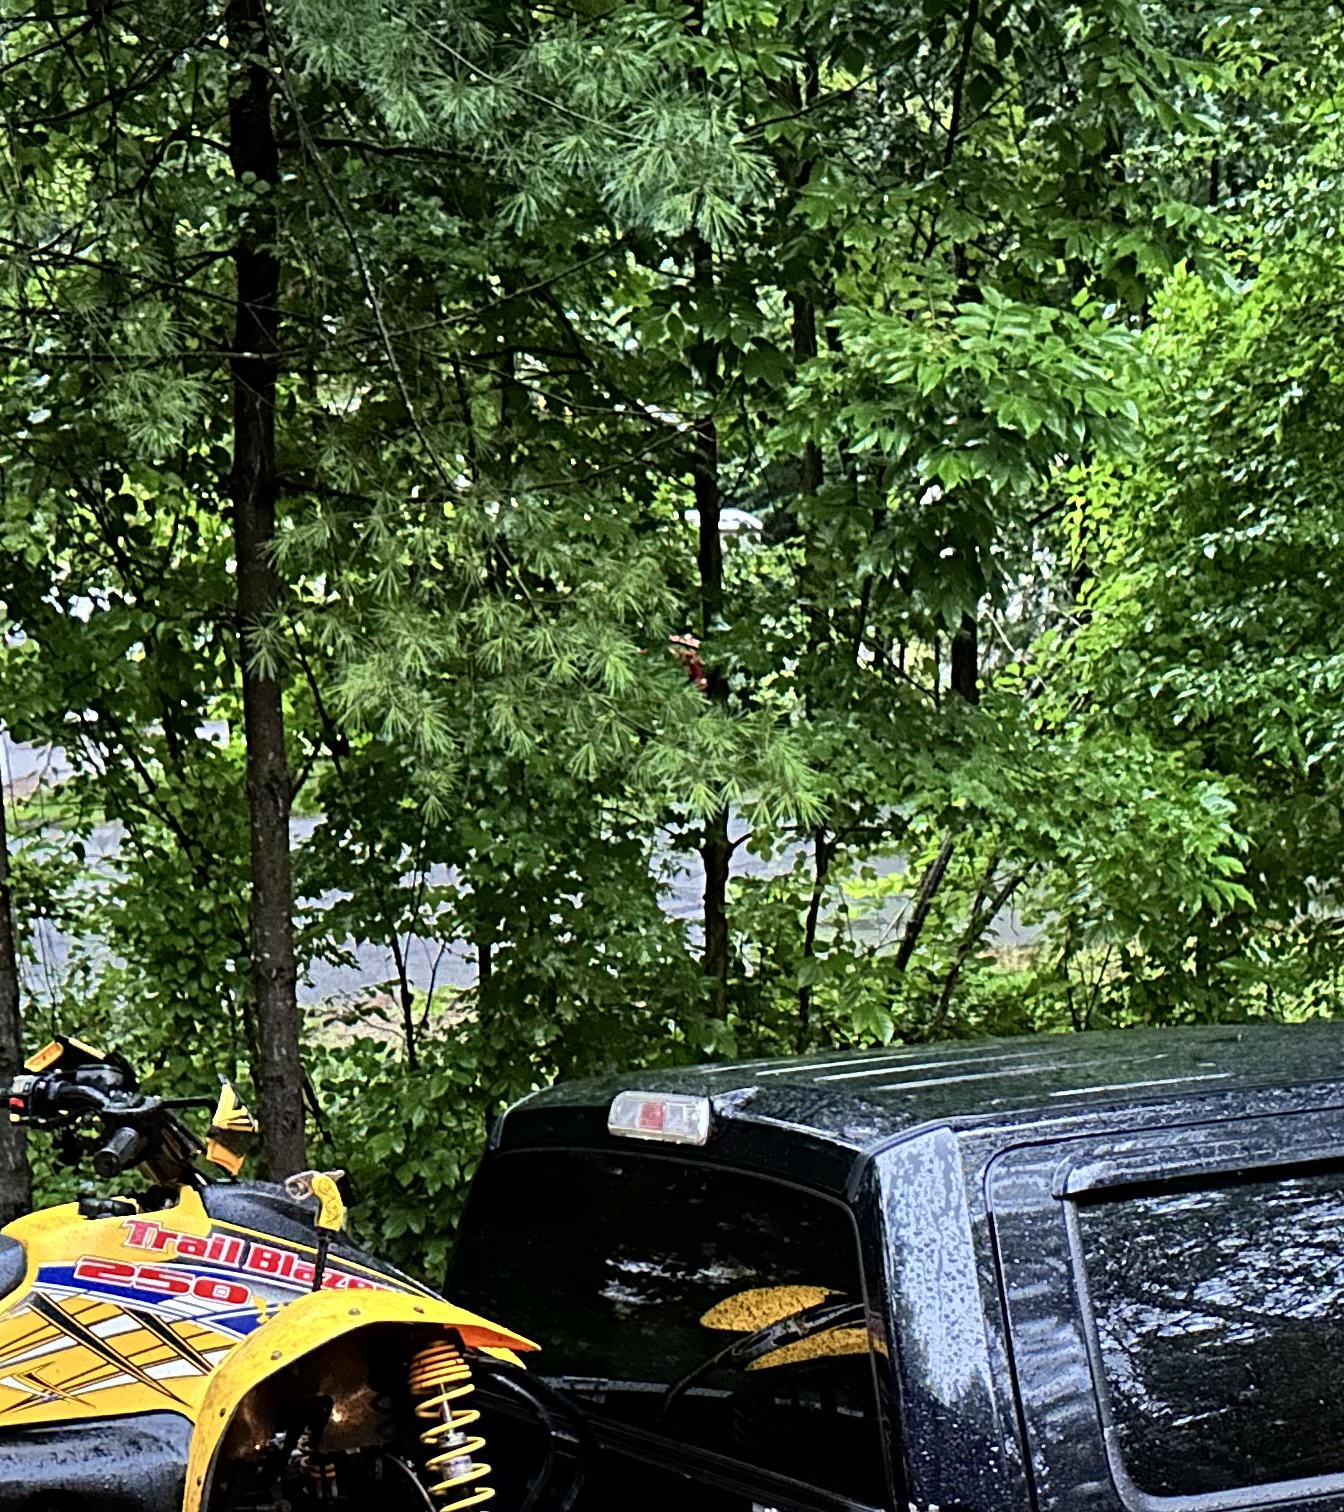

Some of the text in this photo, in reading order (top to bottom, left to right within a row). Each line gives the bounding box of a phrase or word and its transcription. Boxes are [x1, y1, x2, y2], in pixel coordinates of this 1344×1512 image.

[74, 1256, 252, 1307] 250
[121, 1219, 394, 1292] Trail Blaze
